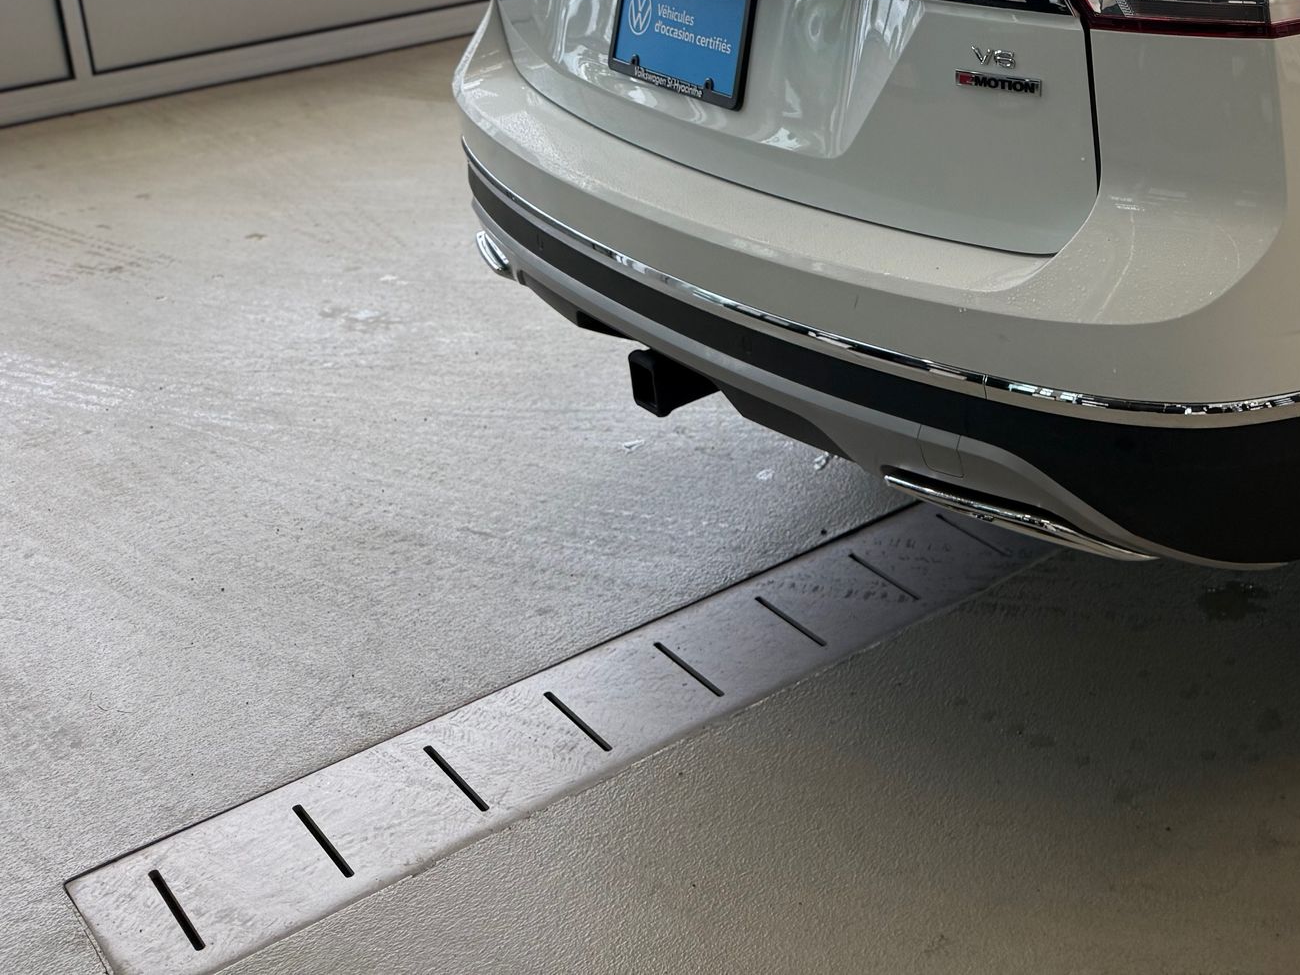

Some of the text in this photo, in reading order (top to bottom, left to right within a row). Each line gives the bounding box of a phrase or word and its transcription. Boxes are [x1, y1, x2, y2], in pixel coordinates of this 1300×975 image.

[657, 3, 695, 25] Véhicules
[654, 20, 732, 54] d'occasion certifiés
[971, 45, 1016, 69] V6
